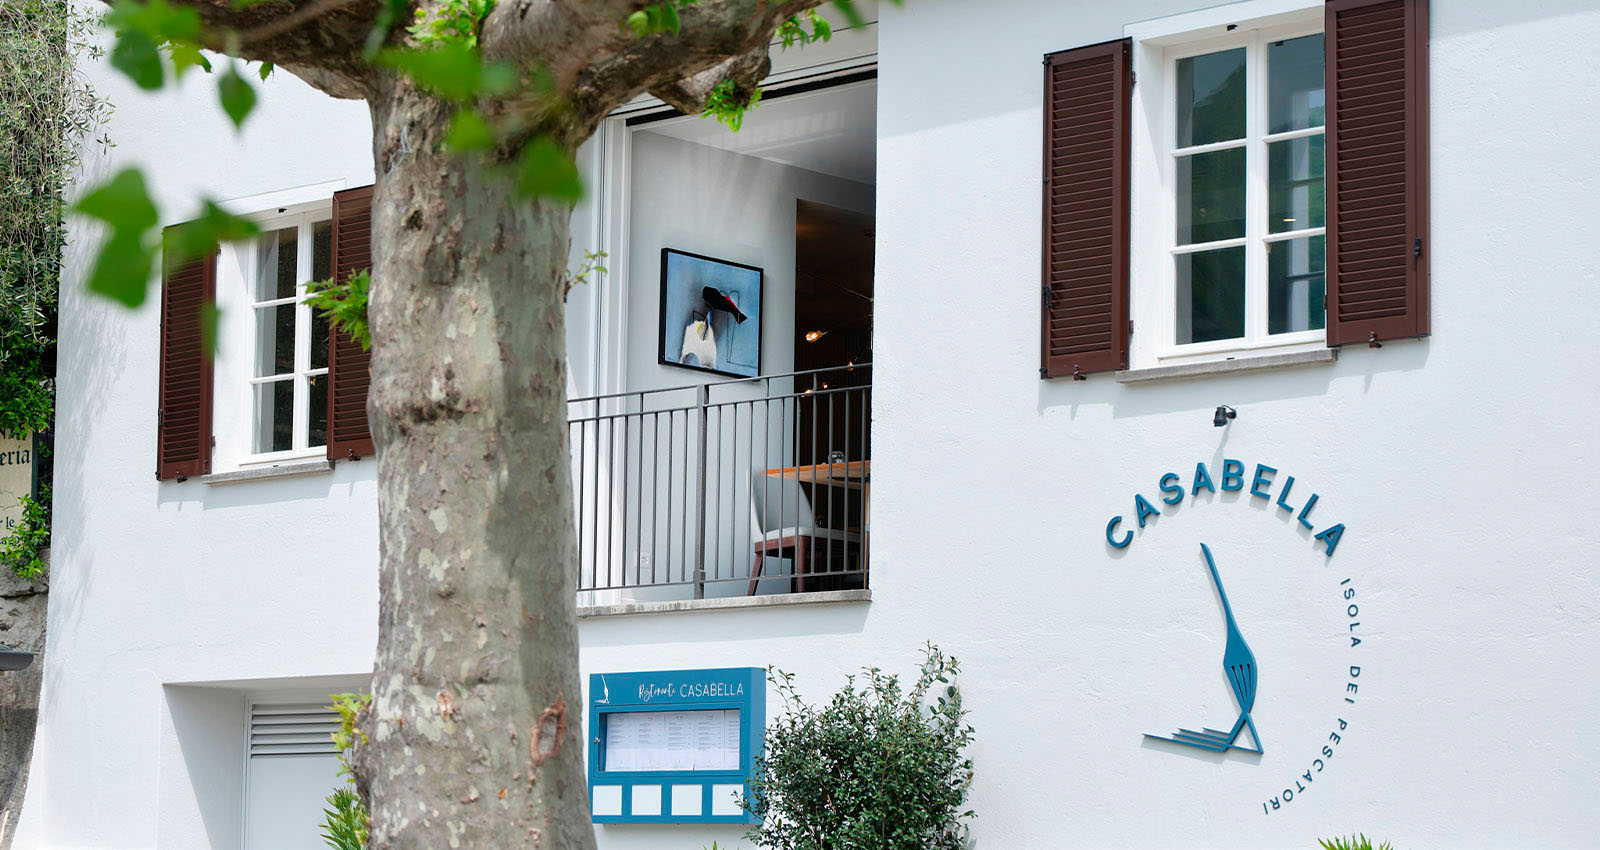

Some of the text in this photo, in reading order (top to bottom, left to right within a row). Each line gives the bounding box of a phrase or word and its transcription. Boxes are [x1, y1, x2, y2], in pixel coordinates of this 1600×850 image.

[1106, 459, 1345, 557] CASABELLA
[680, 682, 744, 698] CASABELLA
[1263, 578, 1361, 815] ISOLA DEI PESCATORI
